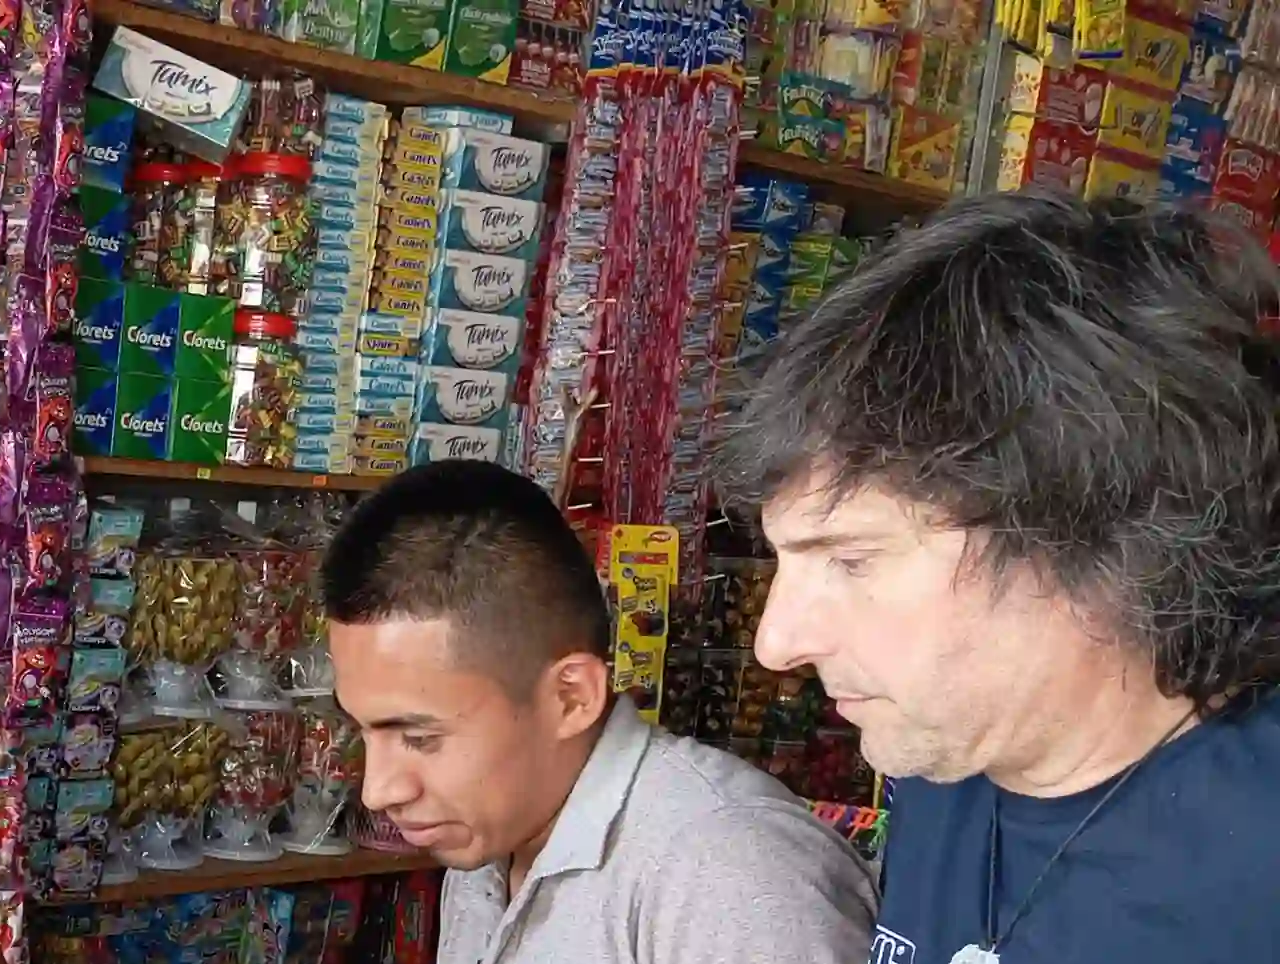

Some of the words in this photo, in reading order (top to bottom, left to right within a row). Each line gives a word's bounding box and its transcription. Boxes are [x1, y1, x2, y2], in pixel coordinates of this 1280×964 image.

[82, 144, 121, 163] orets
[84, 230, 121, 252] lorets
[127, 325, 172, 348] Clorets
[183, 330, 226, 350] Clorets
[74, 411, 108, 428] orets
[120, 412, 165, 433] Clorets
[180, 414, 224, 434] Clorets
